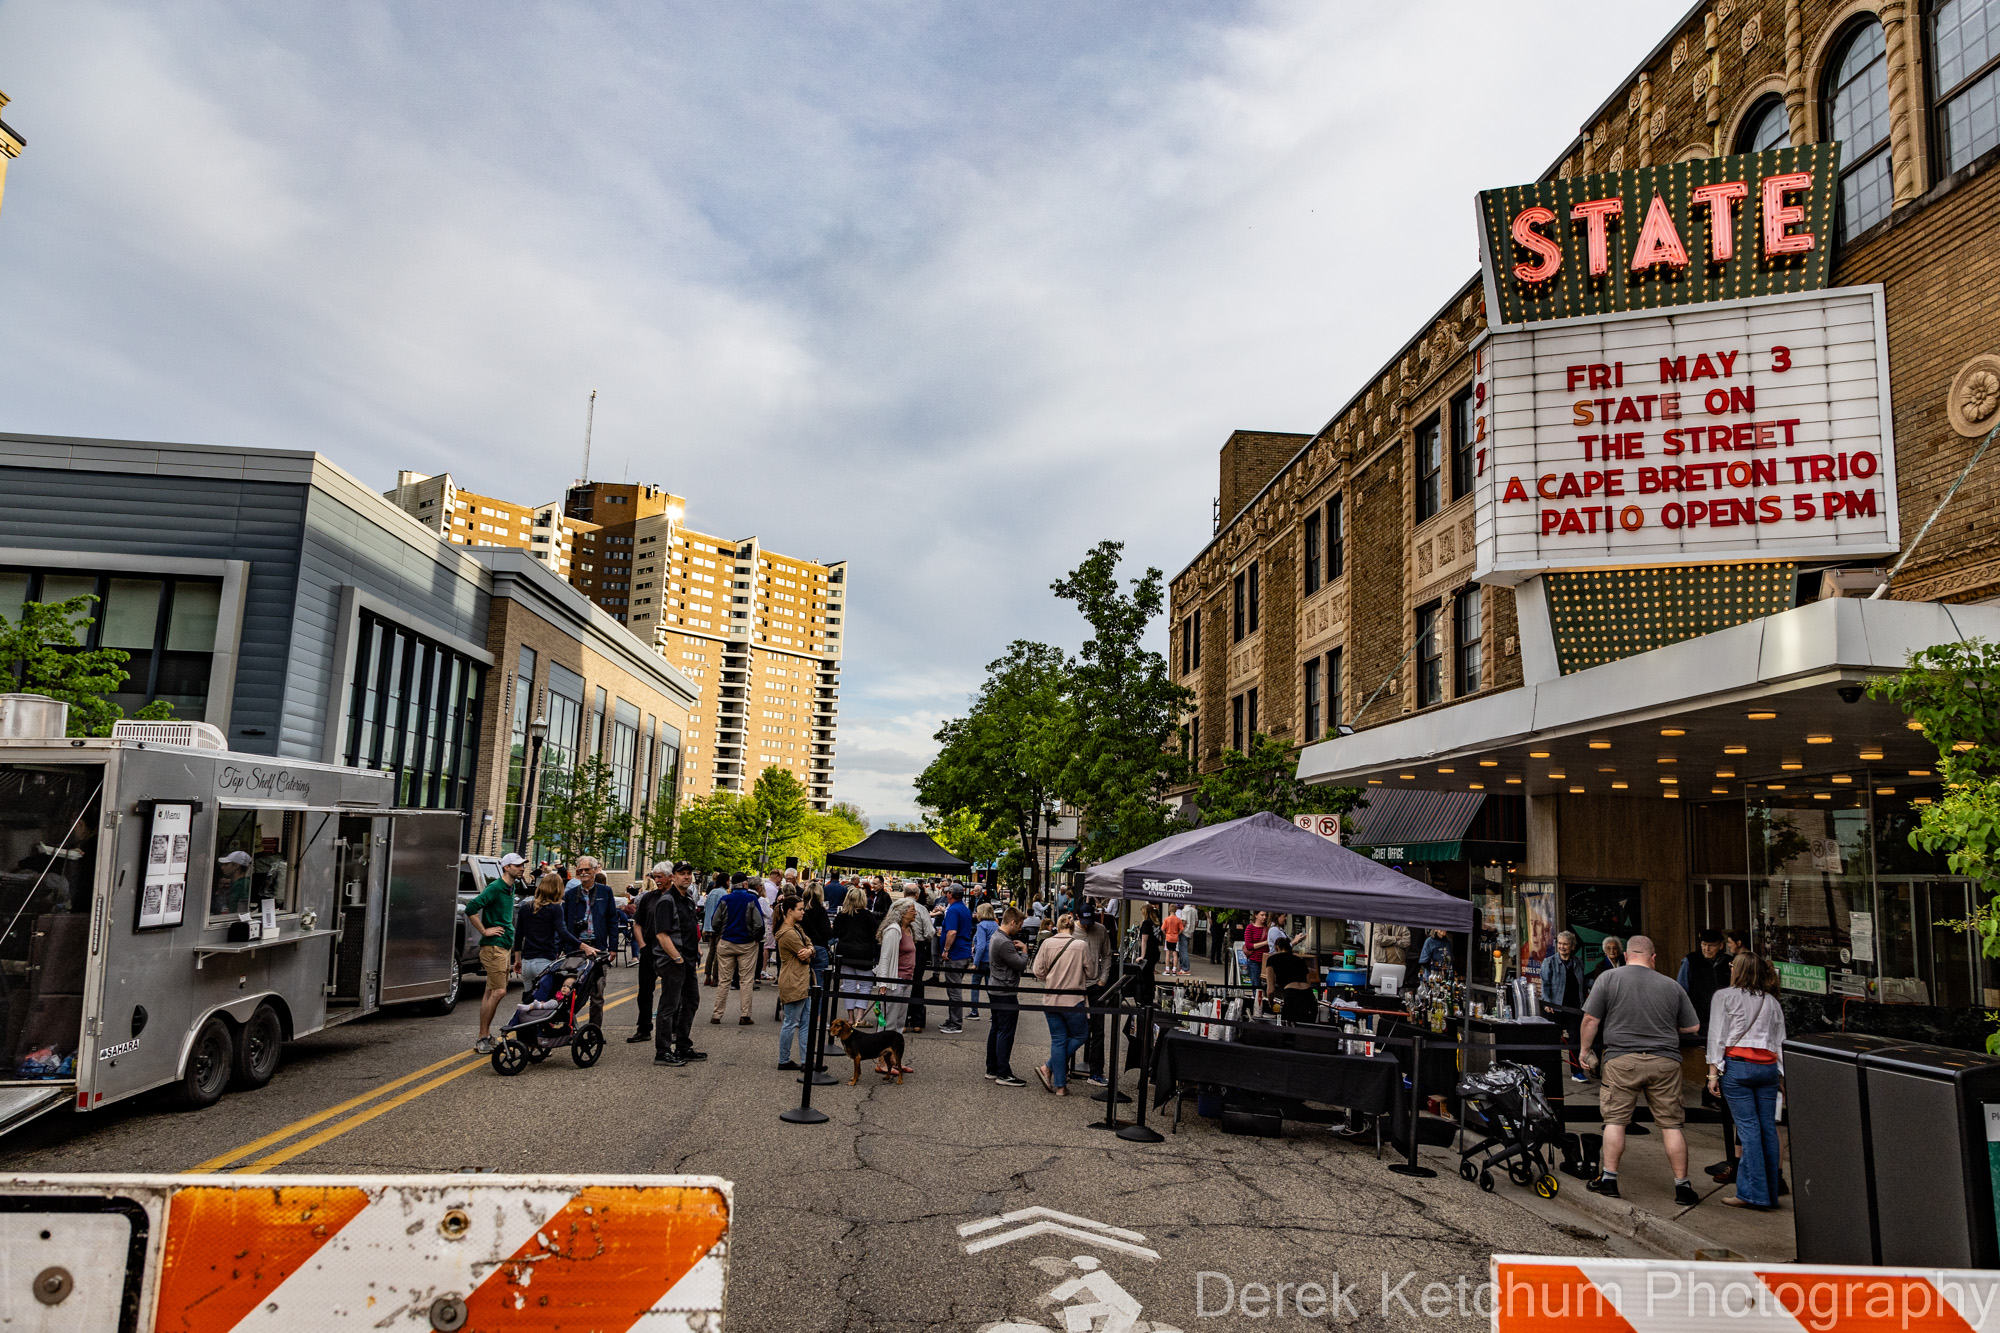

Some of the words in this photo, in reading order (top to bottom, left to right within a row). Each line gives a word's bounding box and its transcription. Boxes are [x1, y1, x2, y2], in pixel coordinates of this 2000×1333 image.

[1511, 171, 1815, 283] STATE
[1566, 361, 1623, 393] FRI
[1659, 350, 1739, 384] MAY
[1771, 346, 1792, 372] 3
[1475, 349, 1486, 478] 1927
[1573, 392, 1682, 427] STATE
[1704, 385, 1755, 416] ON
[1577, 432, 1645, 462] THE
[1663, 418, 1800, 456] STREET
[1502, 476, 1529, 503] A
[1536, 468, 1625, 499] CAPE
[1638, 458, 1777, 495] BRETON
[1785, 450, 1878, 488] TRIO
[1541, 504, 1644, 536] PATIO
[1660, 495, 1783, 530] OPENS
[1793, 492, 1816, 522] 5
[1823, 488, 1877, 521] PM
[219, 766, 243, 793] Top
[245, 767, 276, 797] Shelf
[276, 770, 310, 799] Catering
[163, 810, 181, 820] Menu
[1387, 846, 1404, 860] OFFICE
[1142, 881, 1166, 892] ONE
[1166, 884, 1192, 893] PUSH
[1148, 890, 1185, 899] EXPEDITION
[1783, 963, 1801, 976] WILL
[1803, 966, 1824, 979] CALL
[1789, 977, 1807, 989] PICK
[1809, 979, 1821, 991] UP
[107, 1040, 139, 1057] SAHARA
